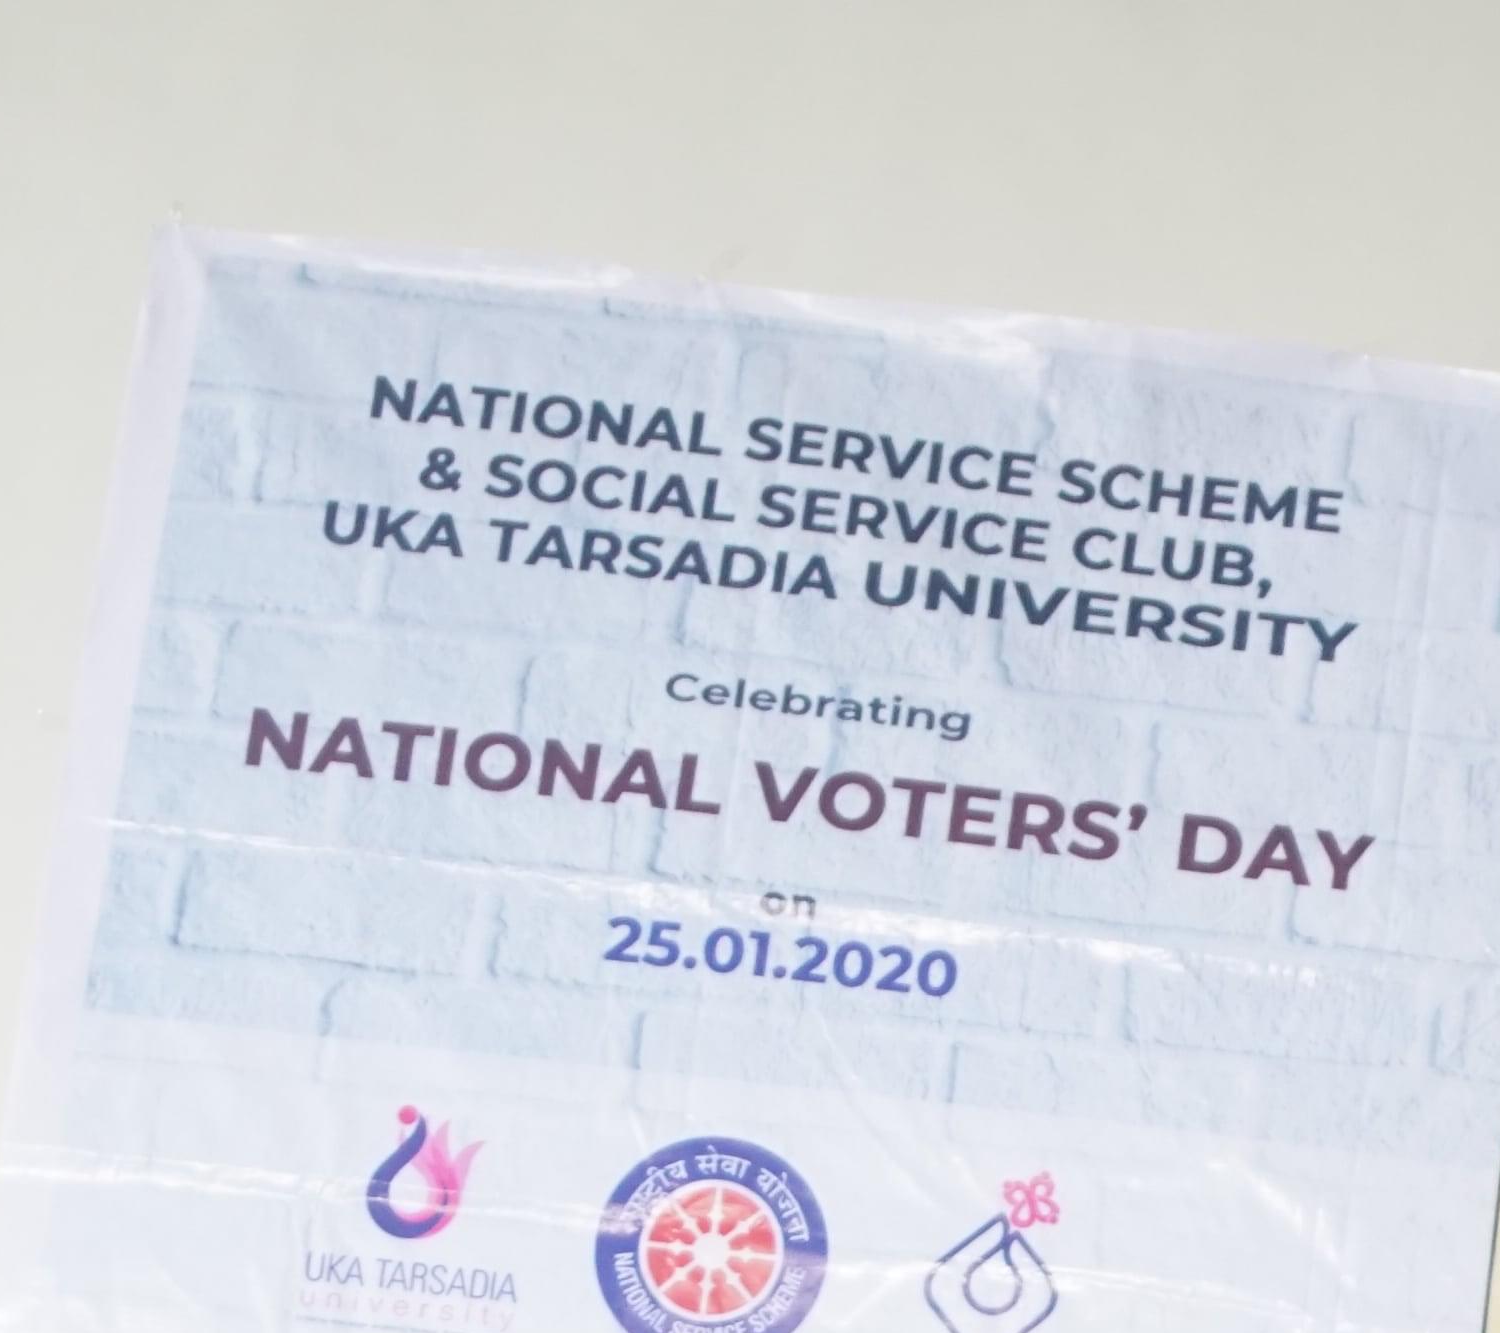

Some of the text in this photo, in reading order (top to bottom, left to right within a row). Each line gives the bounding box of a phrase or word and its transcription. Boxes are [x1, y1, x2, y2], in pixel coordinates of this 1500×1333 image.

[369, 374, 1345, 535] NATIONAL SERVICE SCHEME
[418, 447, 1273, 598] & SOCIAL SERVICE CLUB,
[320, 501, 1359, 663] UKA TARSADIA UNIVERSITY
[665, 672, 973, 742] Celebrating
[244, 707, 722, 816] NATIONAL
[1177, 812, 1376, 892] DAY
[761, 889, 816, 919] on
[603, 916, 959, 998] 25.01.2020
[300, 1289, 516, 1332] university
[305, 1251, 517, 1303] UKA TARSADIA
[614, 1252, 668, 1333] NATIONAL
[748, 1266, 807, 1333] SCHEME
